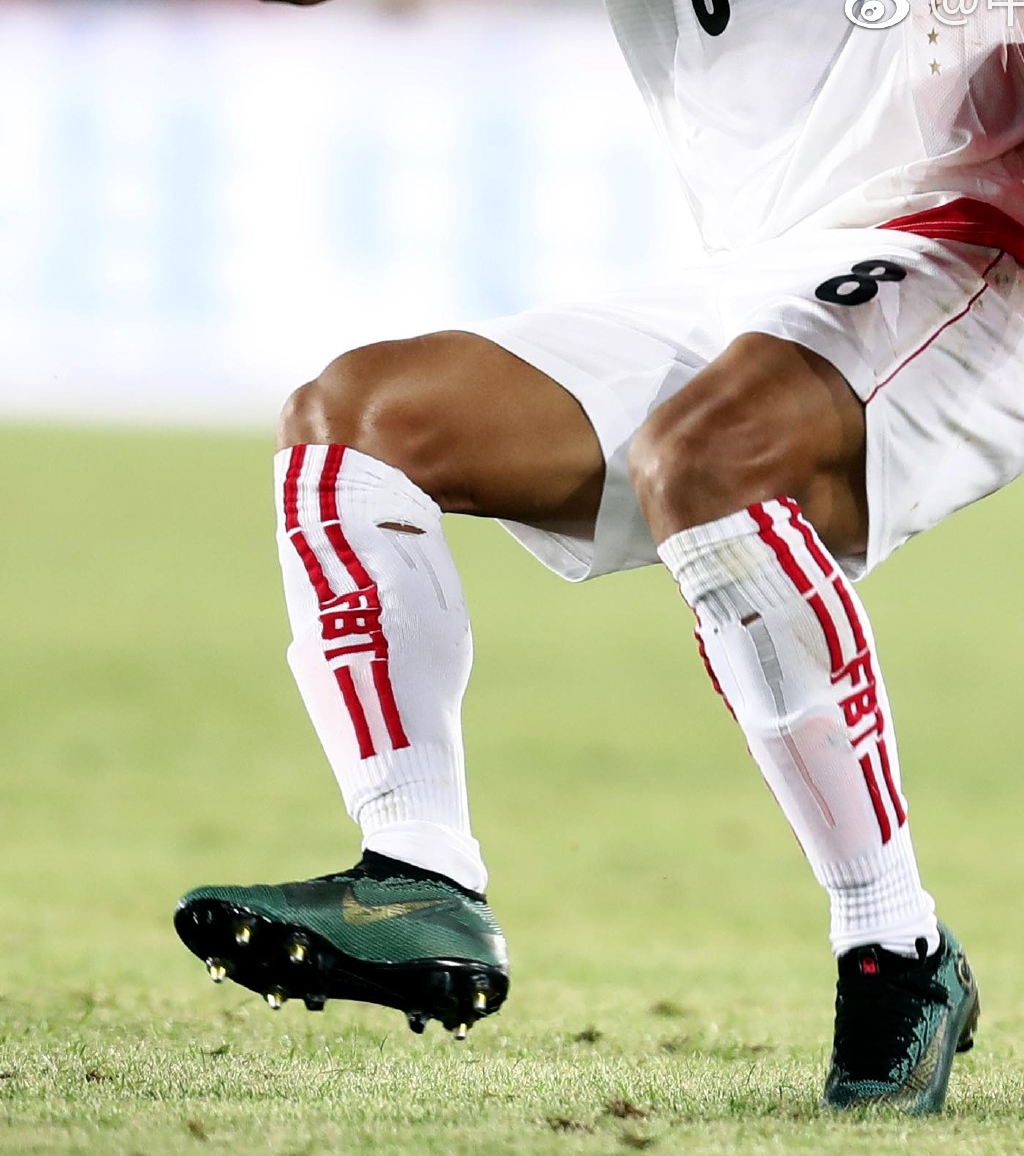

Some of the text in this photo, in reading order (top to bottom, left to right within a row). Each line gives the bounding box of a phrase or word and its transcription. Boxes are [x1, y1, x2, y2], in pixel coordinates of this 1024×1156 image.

[814, 259, 908, 306] 8
[319, 583, 389, 662] FBT
[831, 650, 885, 749] FBT
